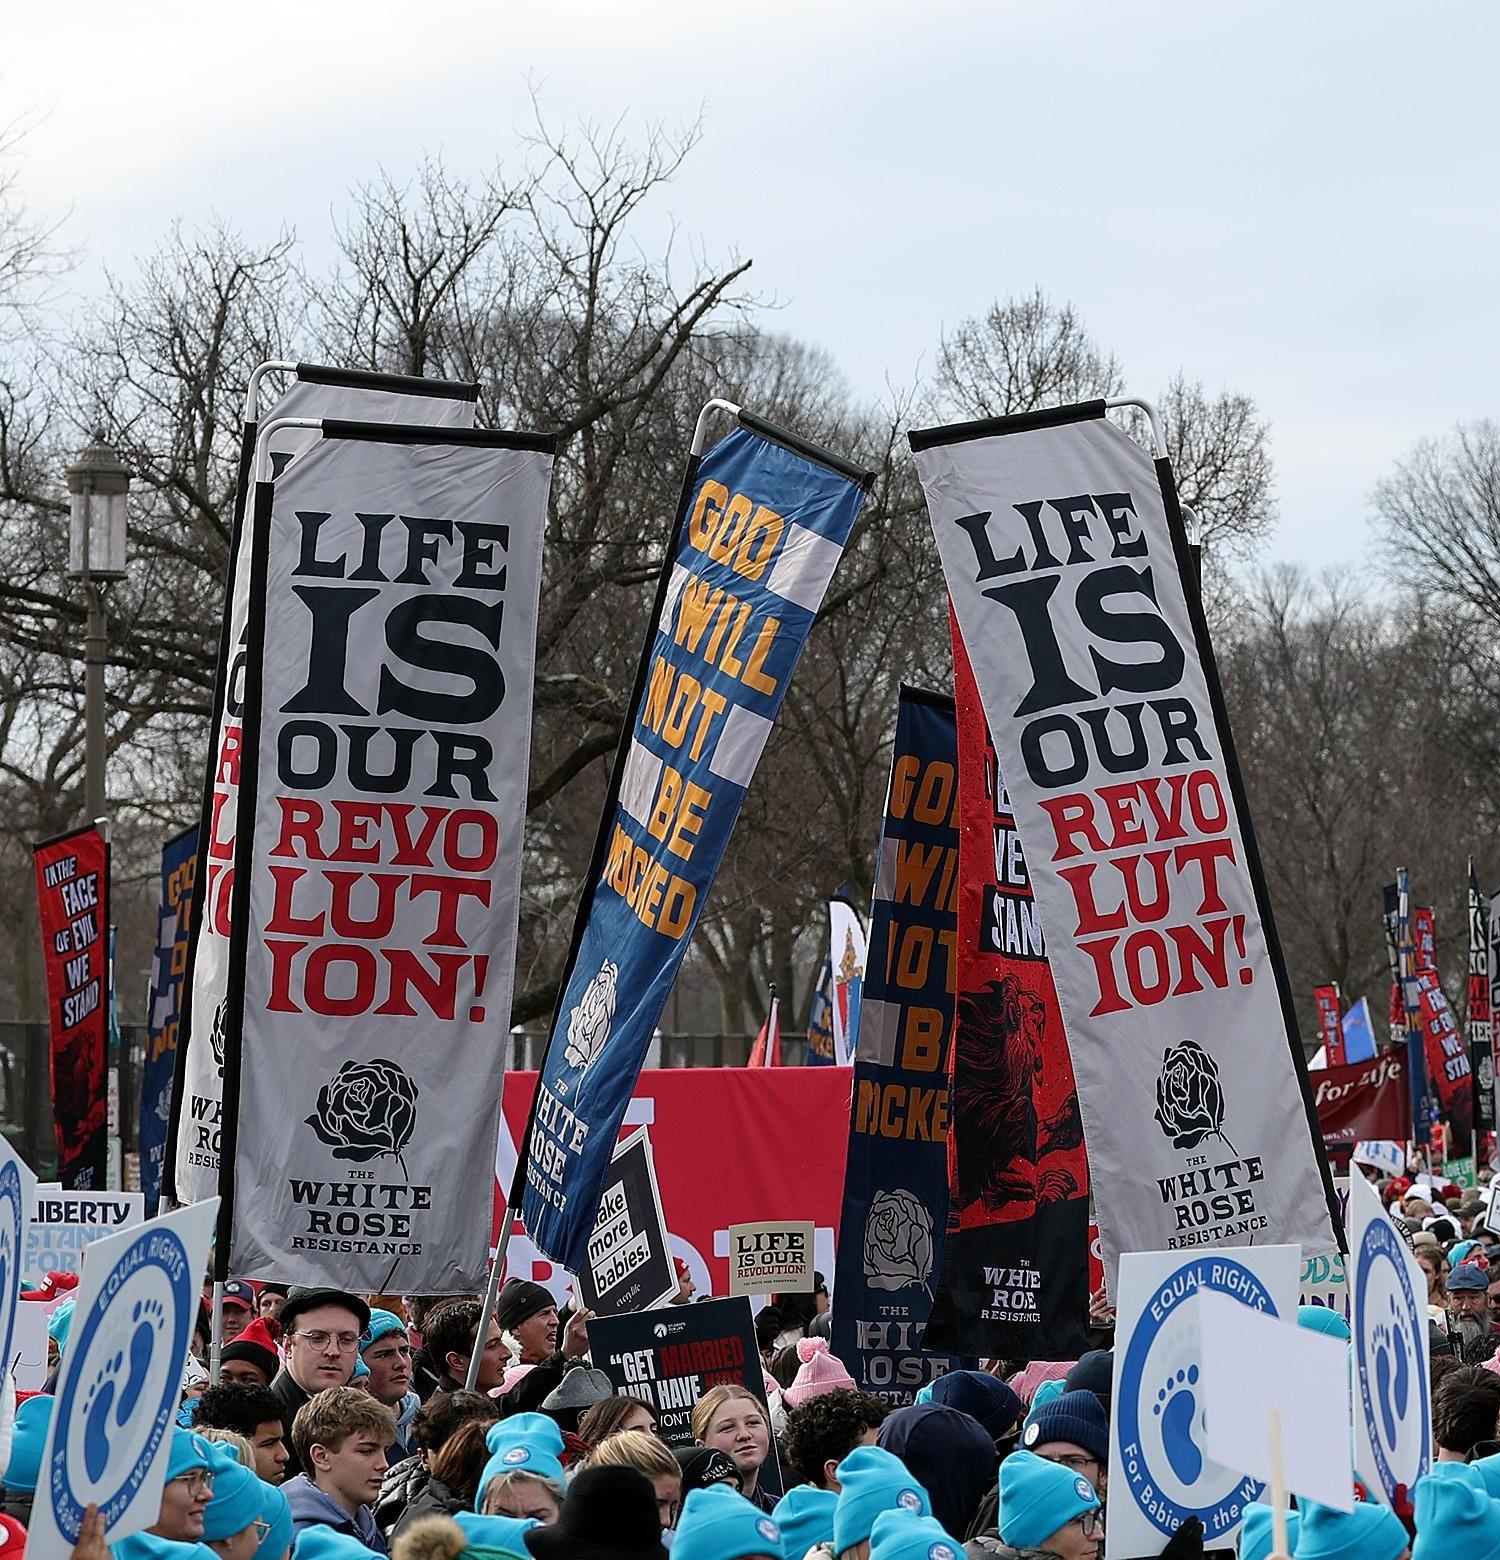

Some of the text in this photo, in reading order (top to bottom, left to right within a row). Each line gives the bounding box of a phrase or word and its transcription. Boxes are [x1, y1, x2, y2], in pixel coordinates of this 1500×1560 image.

[291, 510, 509, 591] LIFE
[688, 478, 785, 582] GOD
[954, 493, 1148, 583] LIFE
[278, 584, 506, 724] IS
[674, 575, 780, 698] WILL
[981, 565, 1186, 717] IS
[641, 657, 728, 763] NOT
[276, 720, 500, 802] OUR
[1020, 698, 1213, 789] OUR
[647, 763, 713, 863] BE
[890, 755, 960, 828] GO
[1038, 769, 1229, 861] REVO
[268, 796, 499, 873] REVO
[44, 856, 77, 888] IN THE
[61, 873, 98, 918] FACE
[1056, 838, 1237, 937] LUT
[264, 866, 491, 948] LUT
[56, 930, 71, 953] OF
[885, 919, 957, 995] OT
[1077, 914, 1253, 1017] ION!
[66, 953, 89, 990] WE
[265, 939, 489, 1023] ION!
[64, 980, 99, 1028] STAND
[901, 1006, 952, 1074] B
[554, 1078, 569, 1096] THE
[1445, 1053, 1471, 1081] STA
[1316, 1079, 1355, 1107] for
[348, 1170, 374, 1180] THE
[1156, 1156, 1264, 1204] WHITE
[1186, 1155, 1207, 1166] THE
[289, 1179, 431, 1210] WHITE
[1174, 1189, 1255, 1230] ROSE
[291, 1236, 422, 1258] RESISTANCE
[307, 1211, 411, 1239] ROSE
[589, 1218, 629, 1263] more
[736, 1232, 804, 1254] LIFE
[1168, 1215, 1269, 1251] RESISTANCE
[24, 1251, 77, 1273] FOR
[99, 1236, 186, 1312] EQUAL RIGHTS
[597, 1242, 650, 1295] babies.
[737, 1251, 806, 1269] IS OUR
[737, 1265, 806, 1279] REVOLUTION!
[879, 1305, 909, 1316] THE
[1151, 1266, 1206, 1322] EQUAL
[1211, 1264, 1266, 1313] RIGHTS
[658, 1336, 745, 1378] MARRIED
[656, 1374, 700, 1410] HAVE
[130, 1408, 170, 1489] Womb
[1124, 1442, 1240, 1532] For Babie the
